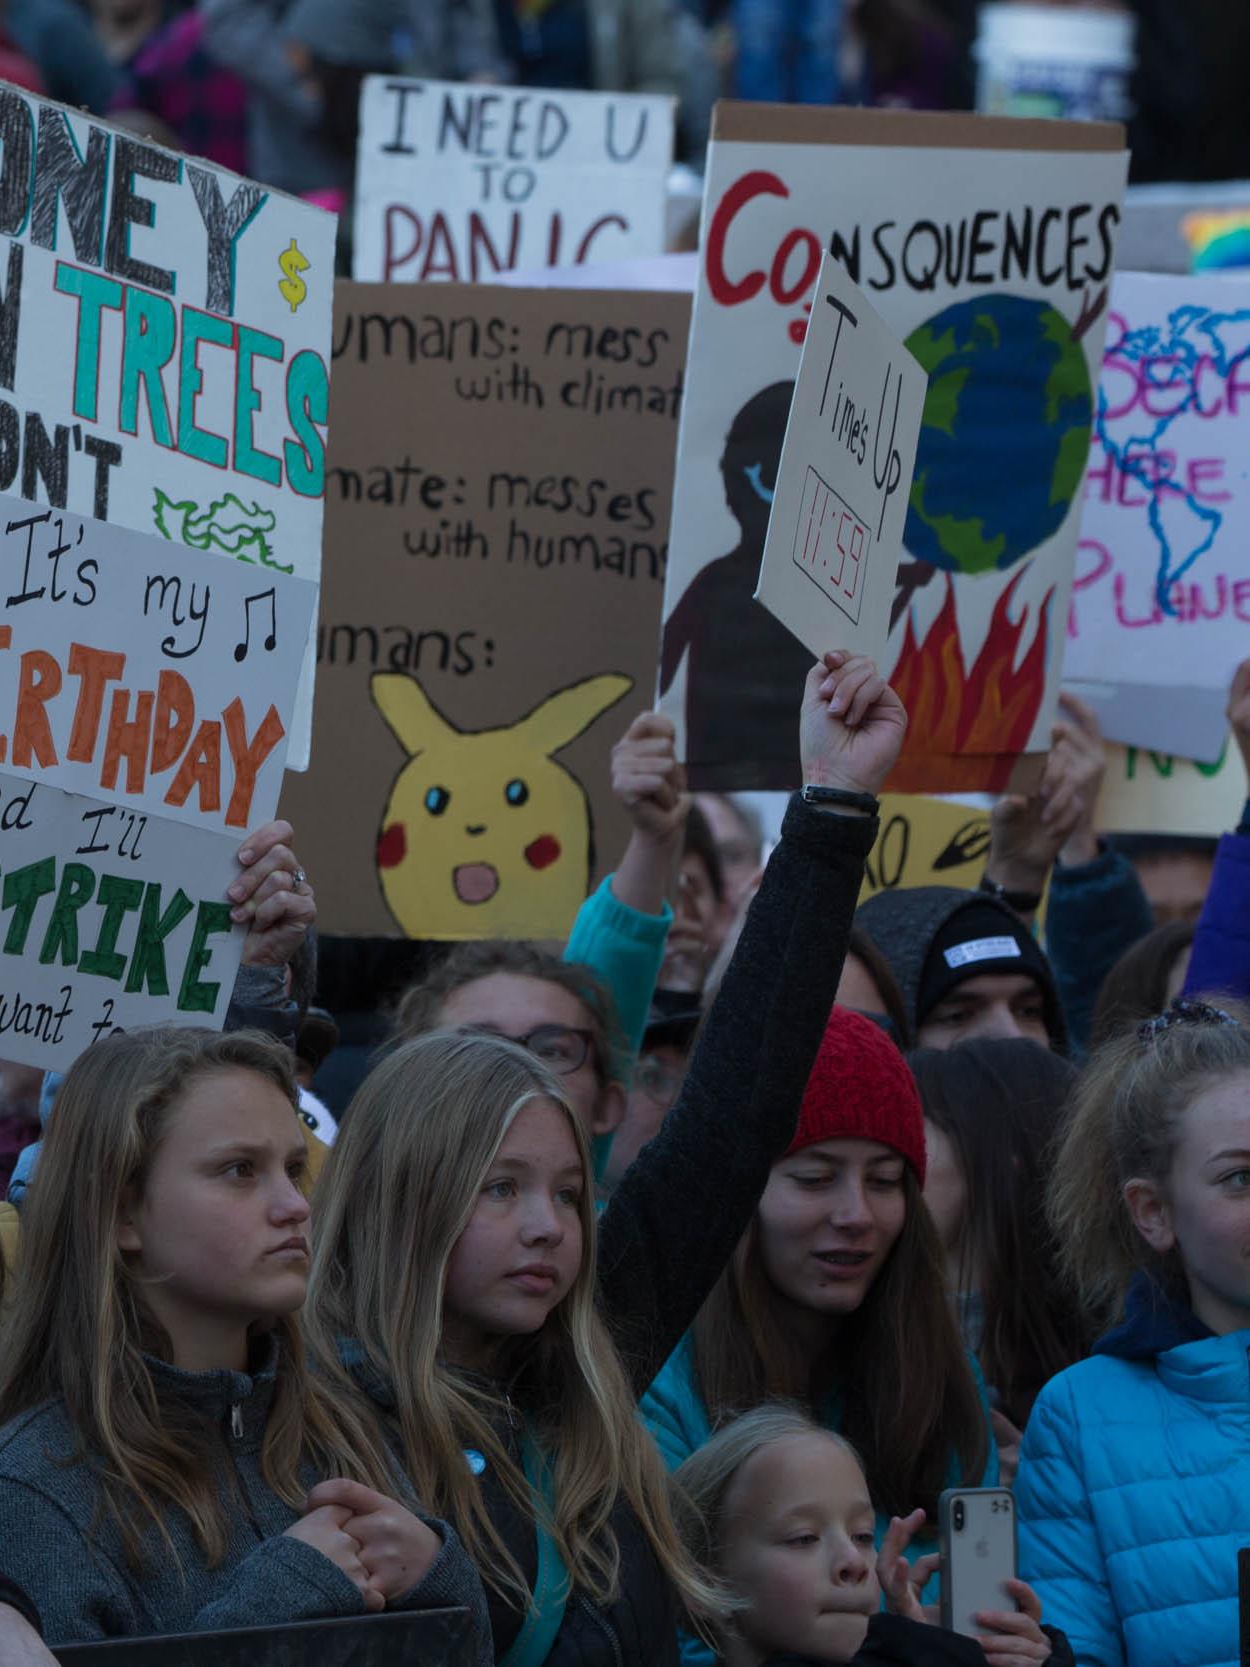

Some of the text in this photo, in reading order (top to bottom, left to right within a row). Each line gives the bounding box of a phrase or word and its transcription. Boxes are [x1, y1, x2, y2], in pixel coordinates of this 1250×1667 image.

[380, 83, 648, 163] I NEED U
[475, 163, 537, 202] TO
[545, 322, 669, 367] mess
[54, 260, 330, 499] TREES
[455, 362, 545, 408] with
[488, 473, 655, 531] messes
[404, 520, 488, 559] with
[802, 480, 863, 599] 11:59
[6, 511, 98, 608] It's
[144, 575, 210, 658] my
[75, 806, 148, 860] I'll
